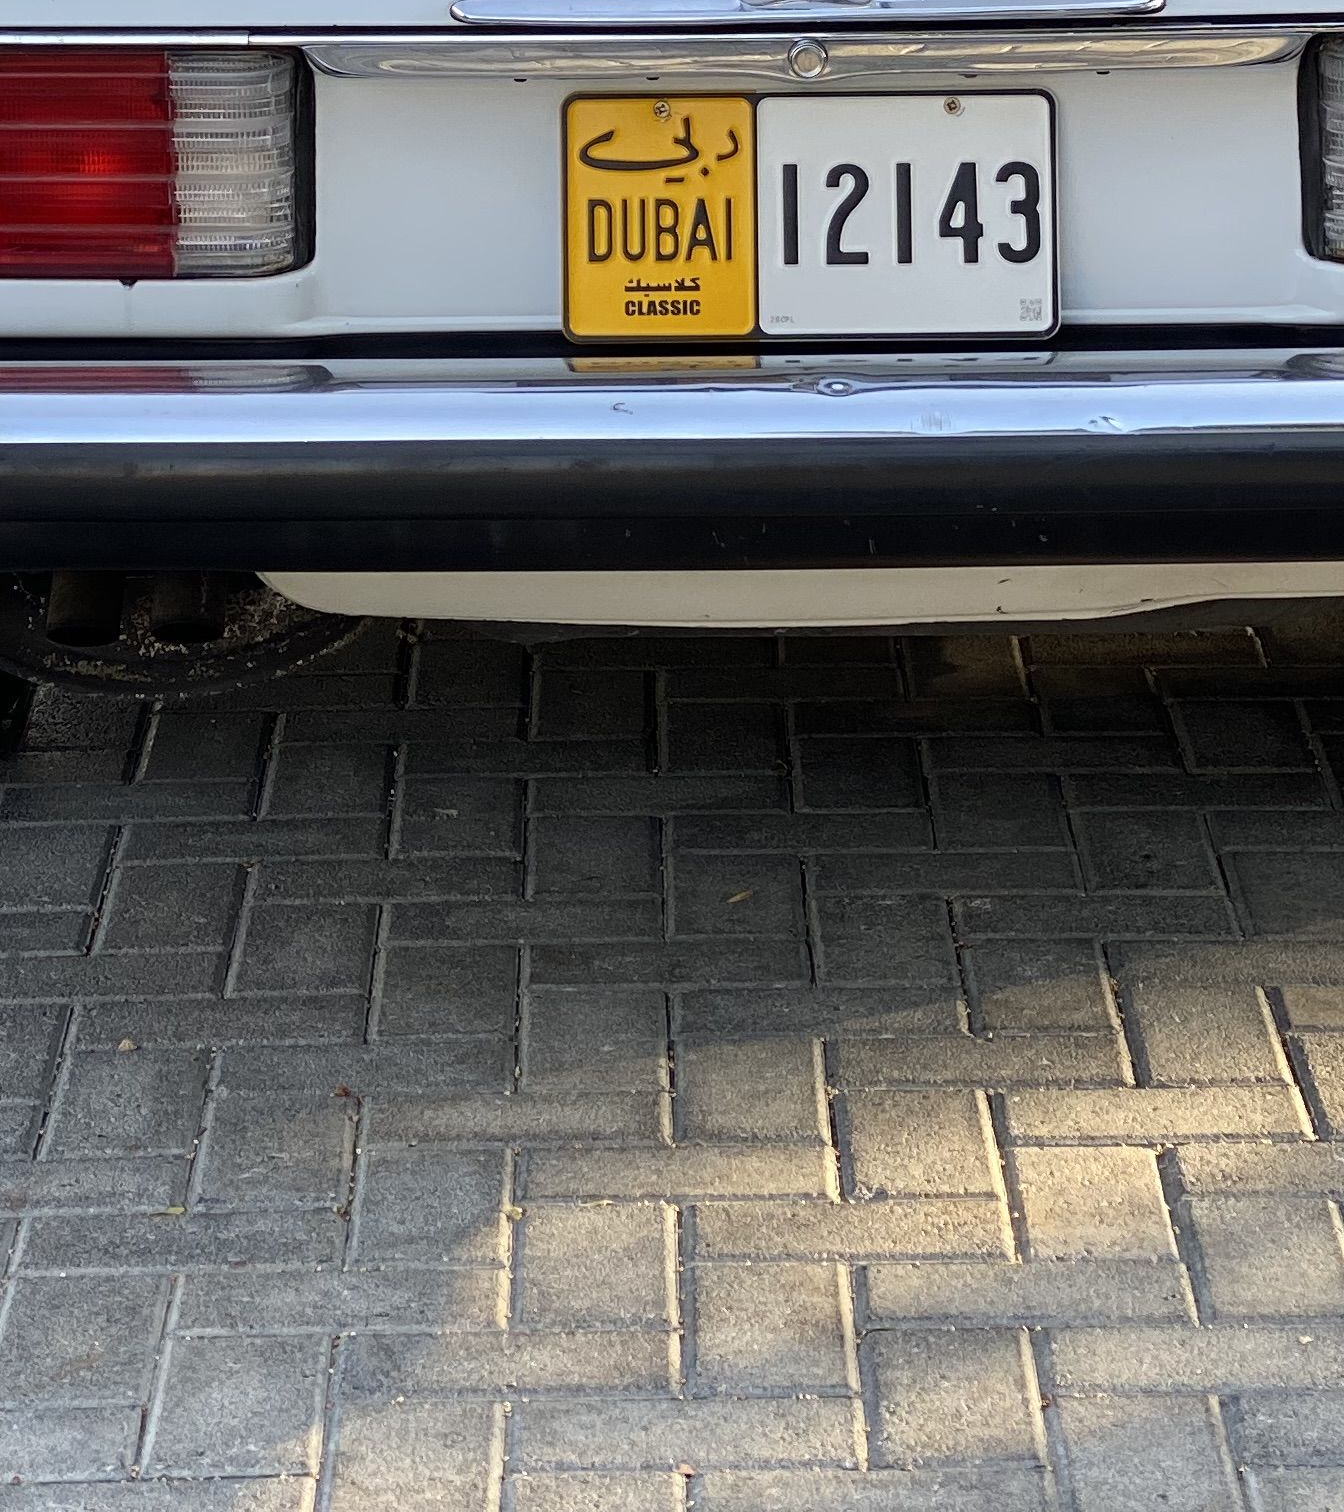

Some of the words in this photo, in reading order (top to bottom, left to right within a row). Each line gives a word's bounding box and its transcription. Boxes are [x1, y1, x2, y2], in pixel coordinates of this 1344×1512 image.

[579, 116, 740, 185] دبي
[587, 198, 733, 263] DUBAI
[782, 161, 1041, 265] 12143
[624, 276, 701, 298] كلاسيك
[624, 299, 701, 317] CLASSIC
